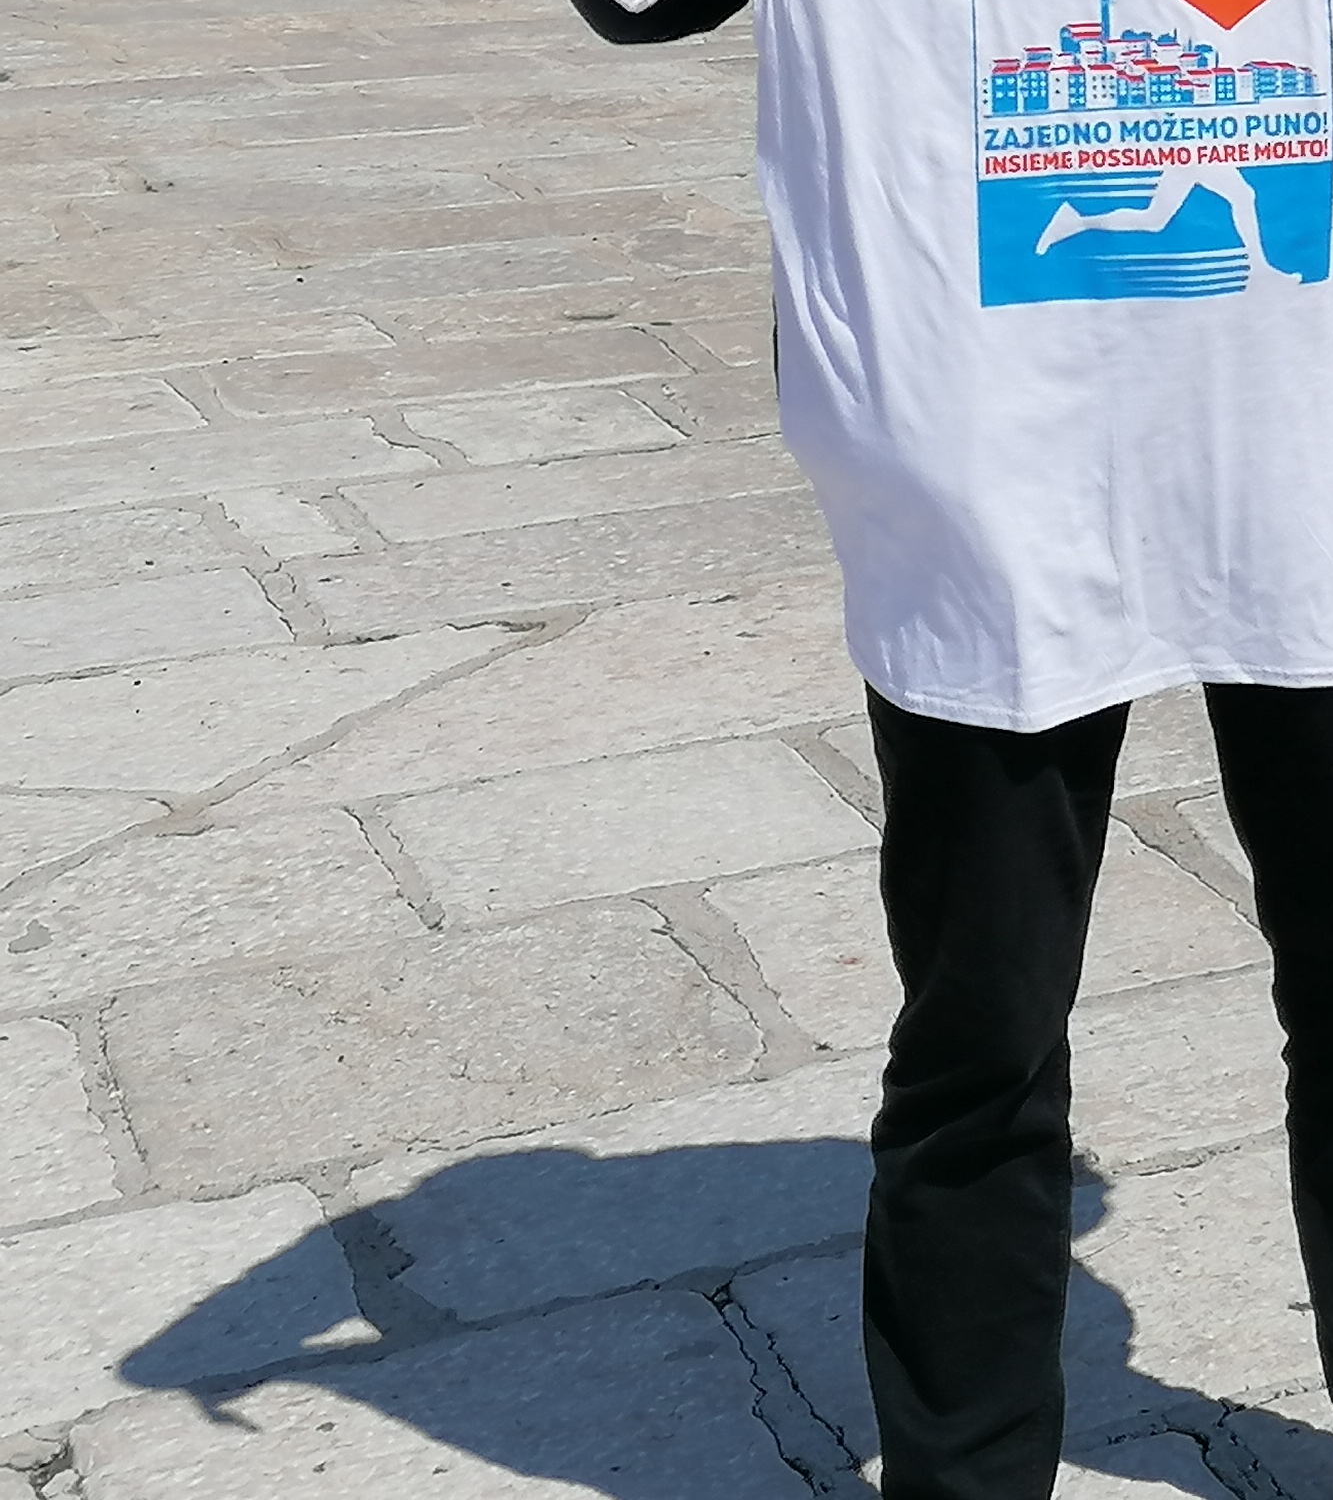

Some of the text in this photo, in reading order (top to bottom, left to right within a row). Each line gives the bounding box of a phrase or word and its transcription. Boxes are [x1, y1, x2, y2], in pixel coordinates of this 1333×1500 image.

[984, 111, 1329, 151] ZAJEDNO MOŽEMO PUNO!
[985, 138, 1329, 175] INSIEME POSSIAMO FARE MOLTO!
